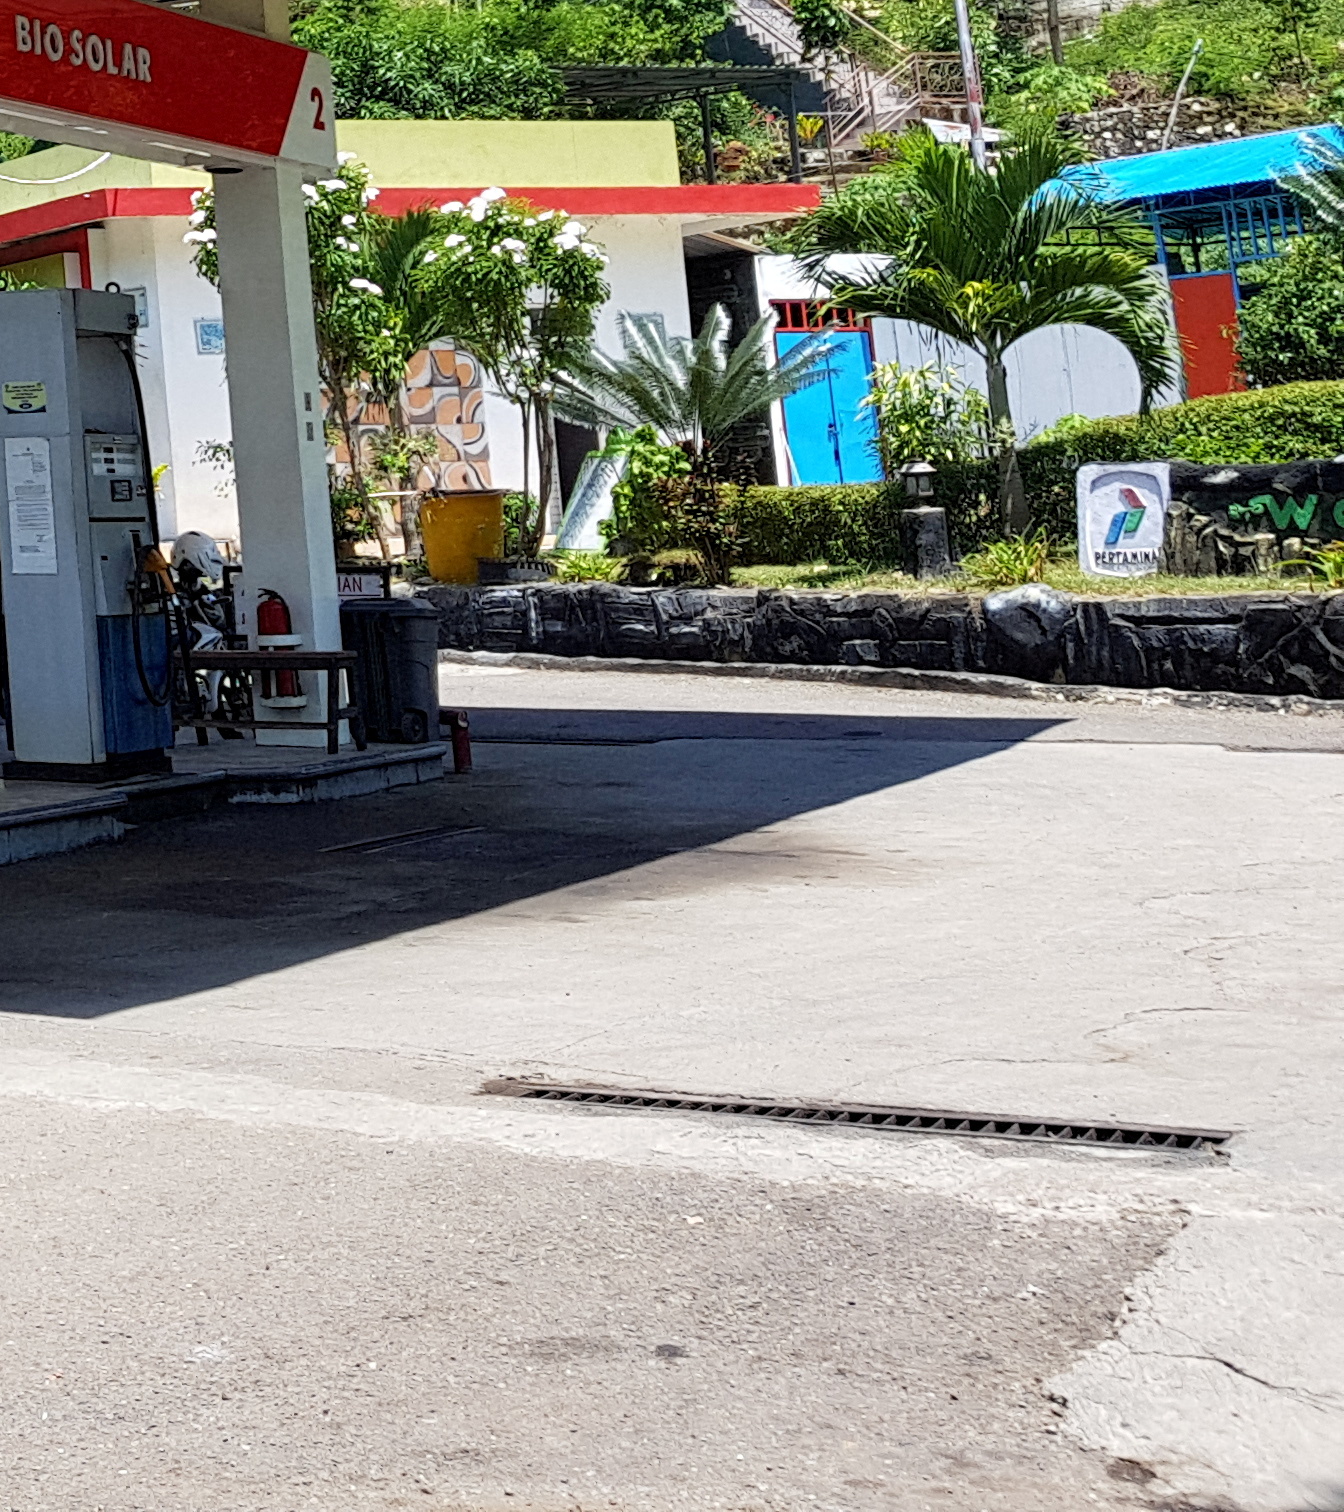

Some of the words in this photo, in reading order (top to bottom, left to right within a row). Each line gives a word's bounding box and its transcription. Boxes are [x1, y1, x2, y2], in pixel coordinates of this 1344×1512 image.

[15, 14, 64, 62] BIO
[69, 29, 152, 83] SOLAR
[310, 86, 326, 131] 2
